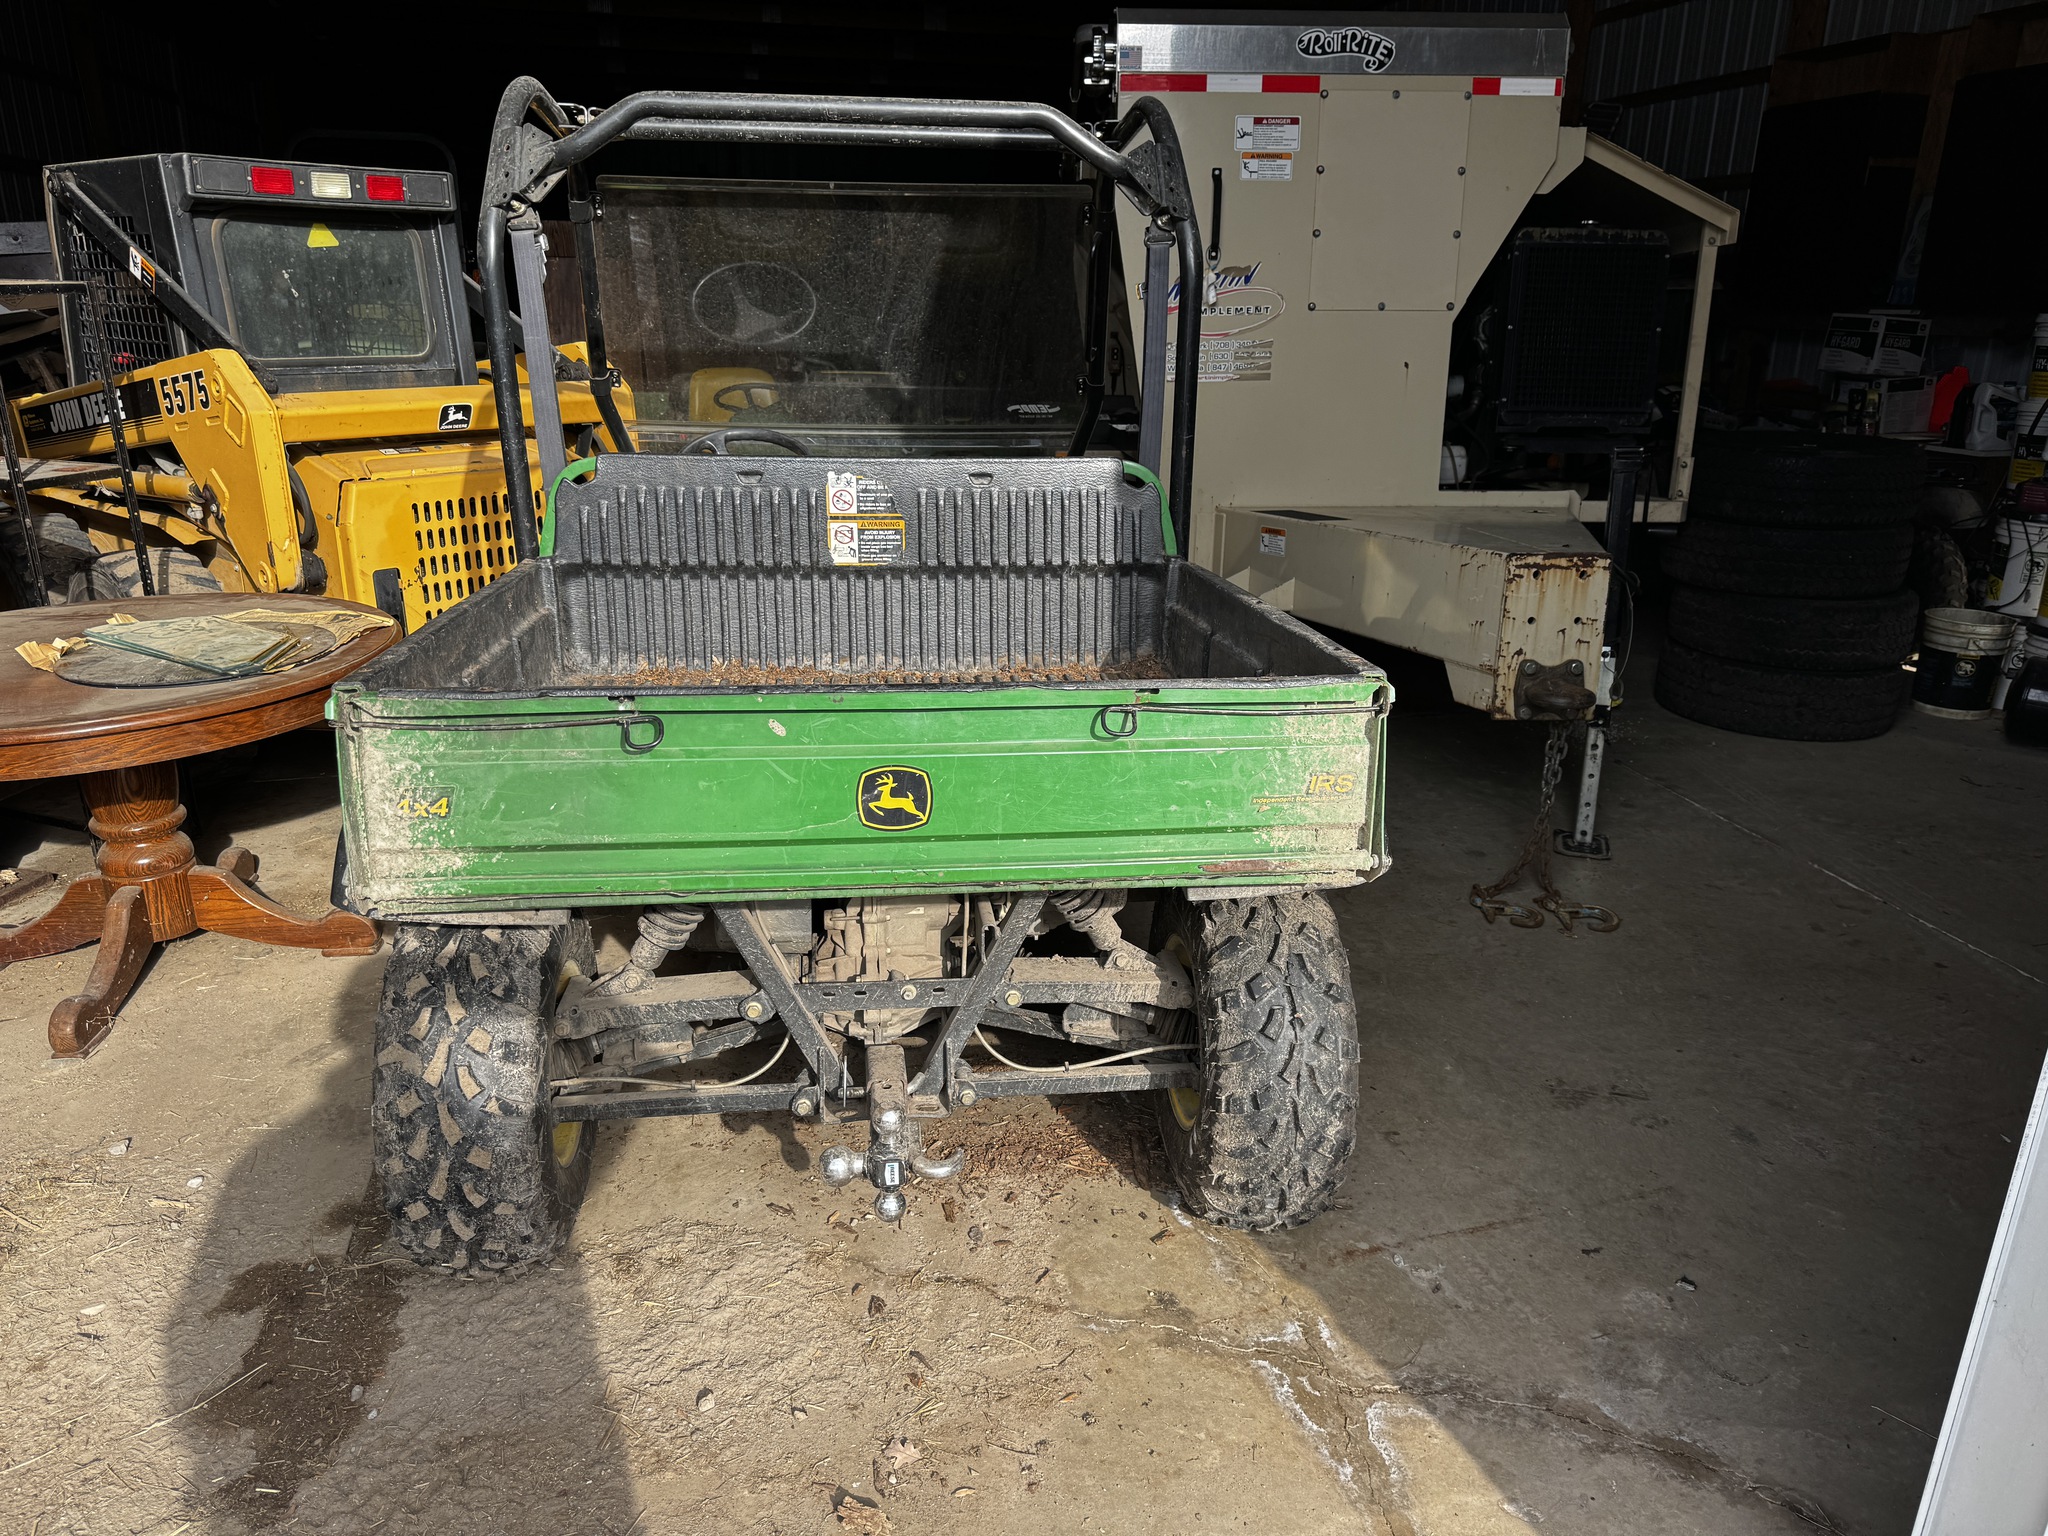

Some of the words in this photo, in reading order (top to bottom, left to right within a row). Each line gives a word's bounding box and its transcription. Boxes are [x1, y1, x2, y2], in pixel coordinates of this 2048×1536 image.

[1200, 306, 1271, 316] MPLEMENT
[1830, 335, 1861, 349] HY-GARD
[1884, 336, 1911, 349] HY-GARD
[159, 368, 211, 418] 5575
[50, 398, 84, 434] JOHN
[81, 388, 126, 427] DEEE
[1308, 773, 1356, 794] IRS
[397, 797, 449, 818] 4x4
